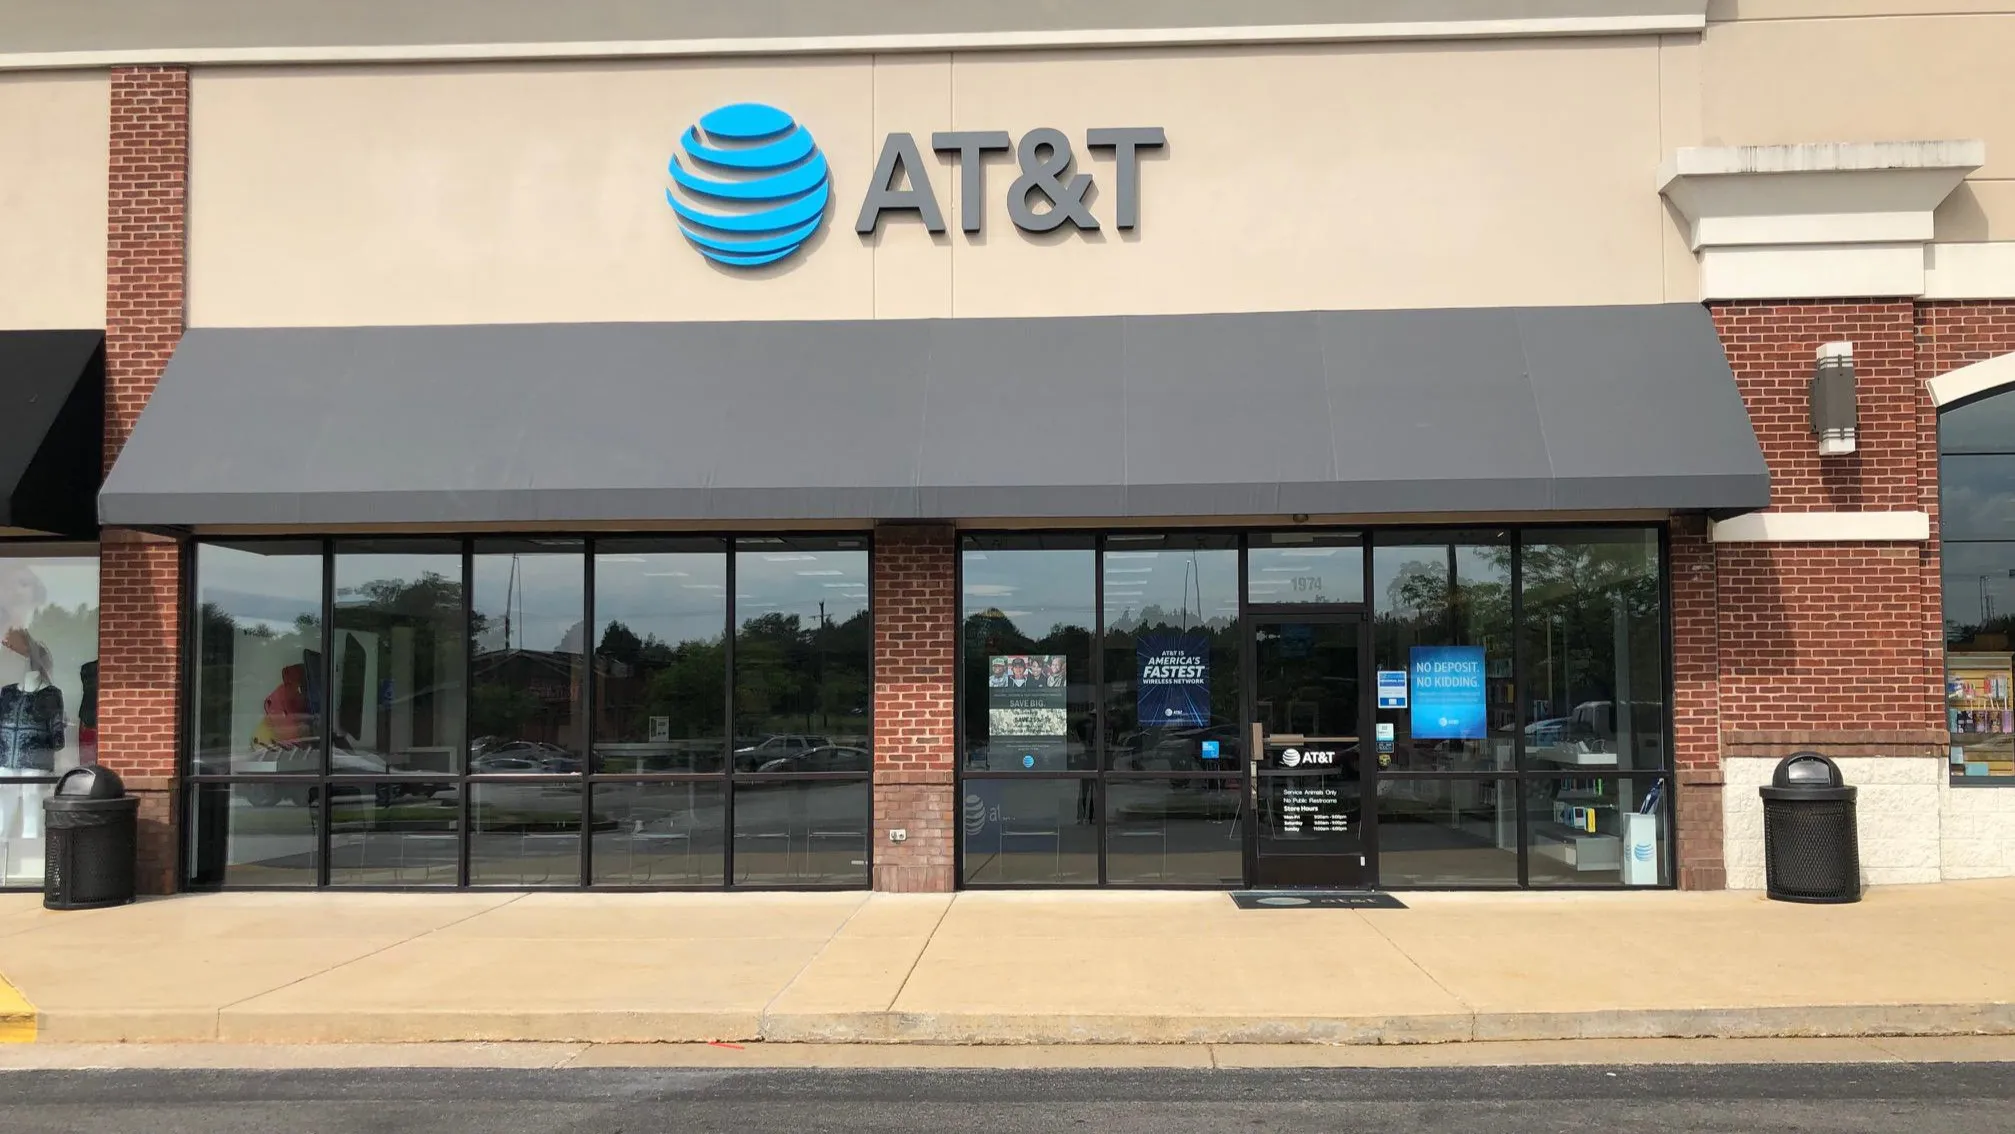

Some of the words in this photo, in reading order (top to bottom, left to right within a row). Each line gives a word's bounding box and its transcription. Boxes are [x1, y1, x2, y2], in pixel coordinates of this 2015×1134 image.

[854, 126, 1165, 235] AT&T
[1291, 576, 1321, 590] 1974
[1148, 656, 1201, 665] AMERICA'S
[1143, 665, 1206, 678] FASTEST
[1416, 662, 1432, 673] NO
[1434, 661, 1480, 673] DEPOSIT.
[1416, 676, 1432, 688] NO
[1434, 676, 1480, 688] KIDDING.
[1009, 699, 1029, 708] SAVE
[1030, 699, 1046, 708] BIG.
[1302, 751, 1335, 763] AT&T
